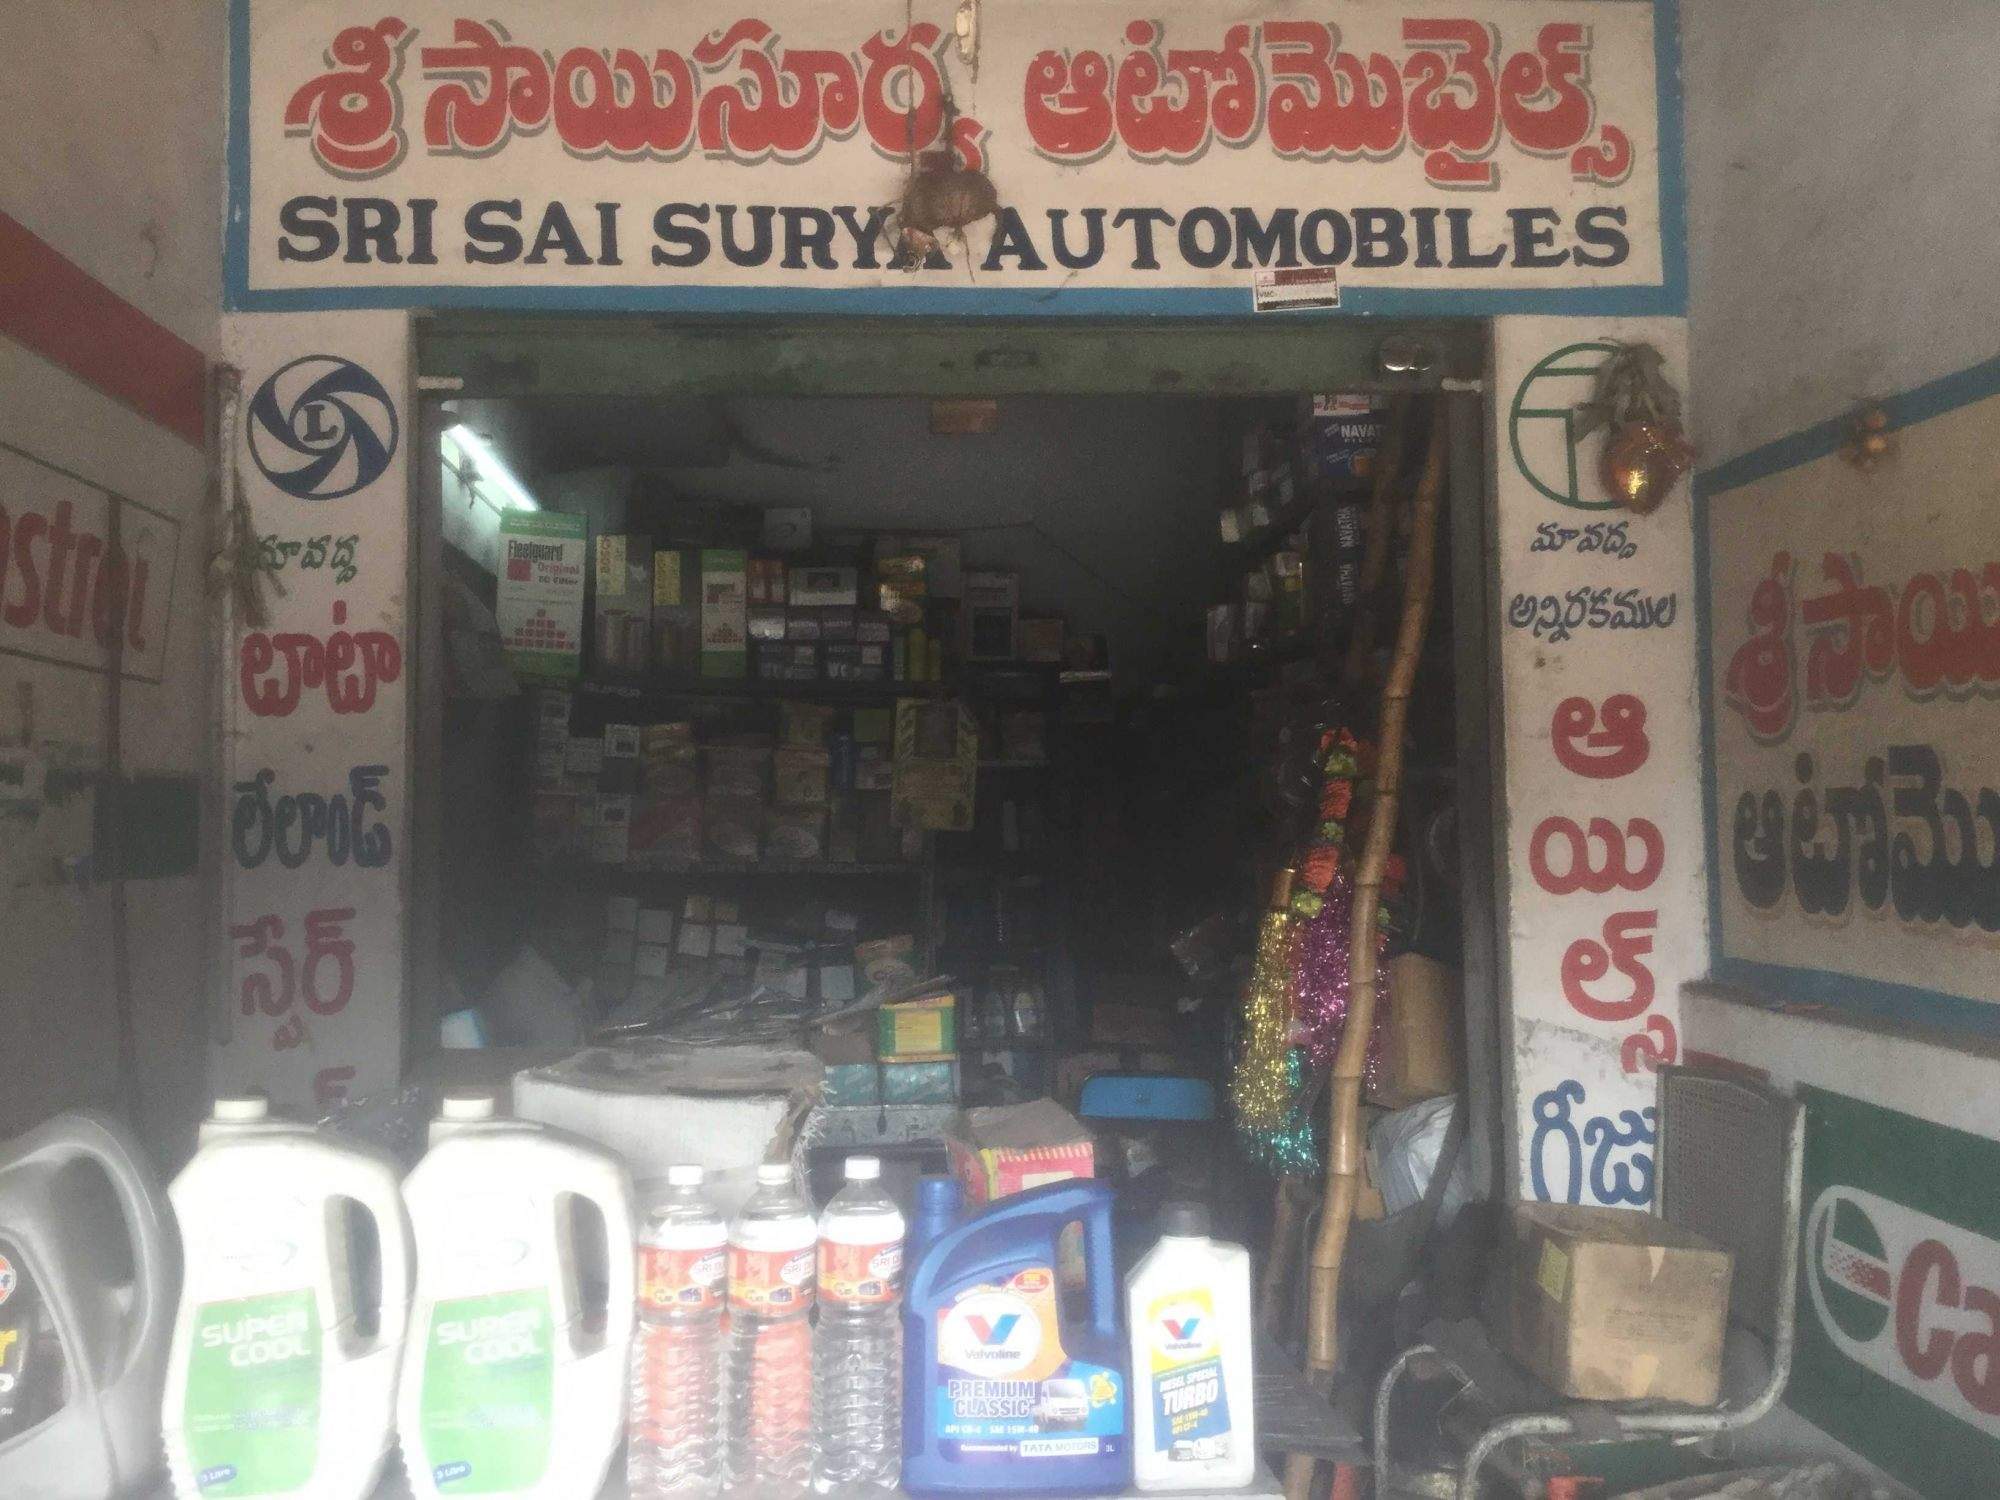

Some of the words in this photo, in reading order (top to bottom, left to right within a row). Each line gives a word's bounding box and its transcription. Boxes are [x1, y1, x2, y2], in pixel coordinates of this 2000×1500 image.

[278, 195, 439, 264] SRI
[464, 201, 622, 267] SAI
[981, 205, 1631, 272] AUTOMOBILES
[241, 600, 401, 717] టాటా
[202, 1311, 309, 1347] SUPER
[229, 1335, 311, 1367] COOL
[965, 1349, 1021, 1360] Valvoline
[948, 1379, 1036, 1398] PREMIUM
[1162, 1378, 1218, 1416] TURBO
[954, 1399, 1031, 1418] CLASSIC
[1023, 1443, 1053, 1453] TATA
[1054, 1440, 1097, 1452] MOTORS
